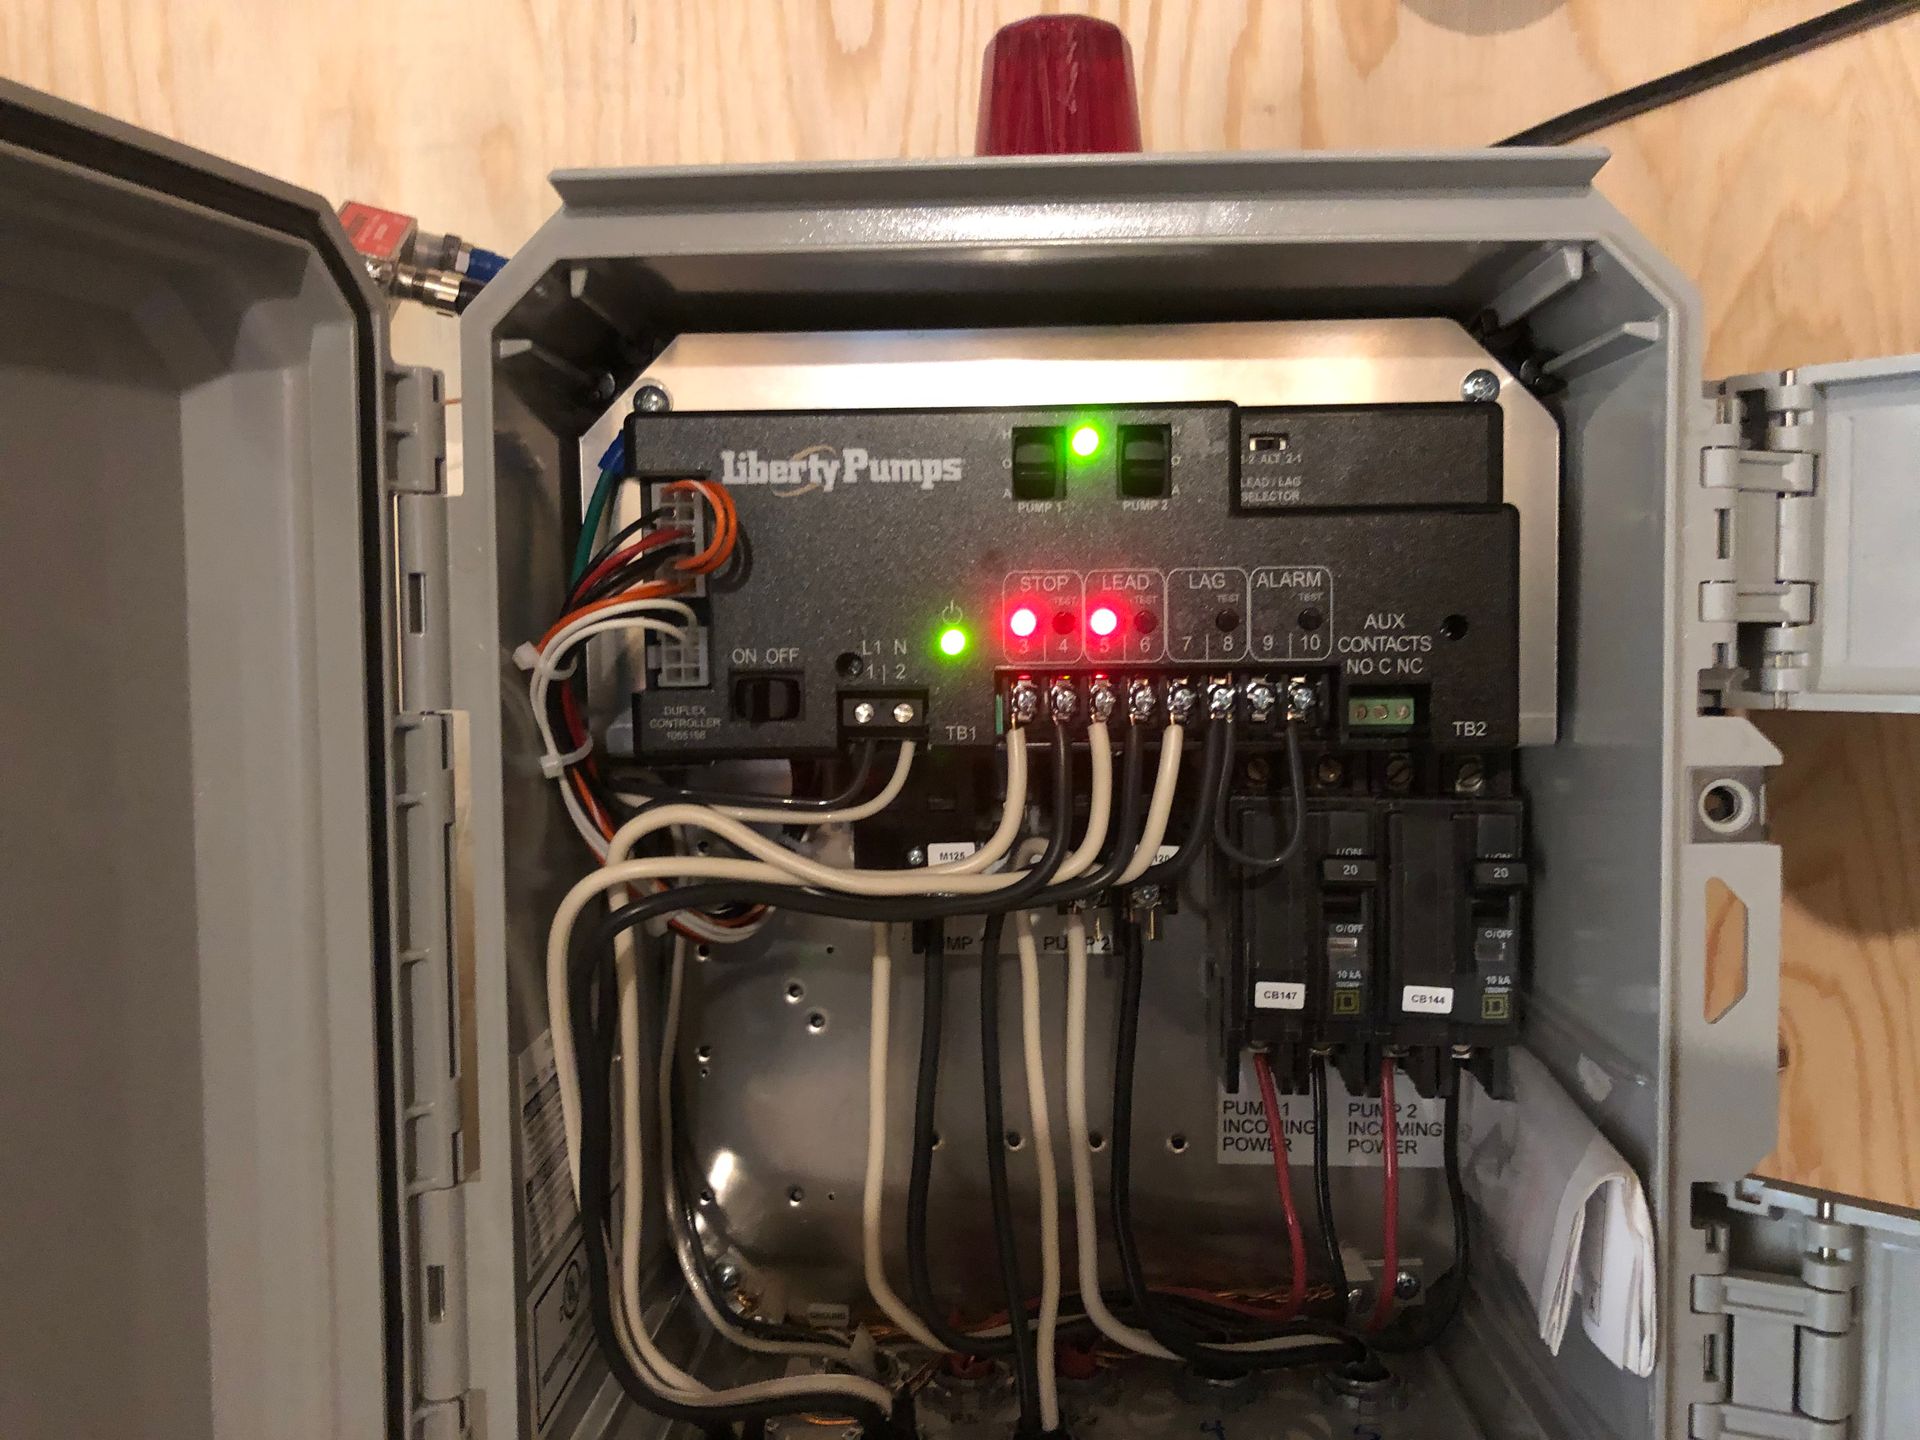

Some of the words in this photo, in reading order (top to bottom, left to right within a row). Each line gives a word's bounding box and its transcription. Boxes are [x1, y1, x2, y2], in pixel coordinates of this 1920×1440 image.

[1172, 427, 1182, 436] H
[1260, 454, 1280, 464] ALT
[720, 449, 839, 492] Liberty
[842, 448, 962, 490] Pumps
[1241, 477, 1270, 488] LEAD
[1278, 476, 1302, 487] LAG
[1171, 485, 1182, 496] A
[1241, 490, 1300, 503] SELECTOR
[1017, 502, 1053, 513] PUMP
[1122, 500, 1157, 512] PUMP
[1160, 500, 1169, 511] 2
[1019, 575, 1069, 592] STOP
[1102, 574, 1150, 590] LEAD
[1188, 572, 1226, 589] LAG
[1255, 571, 1321, 589] ALARM
[1133, 595, 1158, 605] TEST
[1215, 593, 1240, 604] TEST
[1297, 592, 1324, 602] TEST
[1363, 613, 1406, 630] AUX
[862, 640, 882, 656] L1
[894, 640, 908, 655] N
[1018, 638, 1030, 654] 3
[1057, 638, 1069, 653] 4
[1099, 637, 1111, 653] 5
[1139, 636, 1152, 653] 6
[1181, 635, 1193, 652] 7
[1222, 635, 1234, 652] 8
[1262, 634, 1274, 651] 9
[1300, 633, 1321, 651] 10
[1337, 635, 1433, 653] CONTACTS
[732, 648, 757, 664] ON
[765, 647, 800, 665] OFF
[866, 665, 874, 680] 1
[895, 665, 907, 680] 2
[1345, 658, 1373, 675] NO
[1378, 658, 1391, 674] C
[1397, 657, 1424, 674] NC
[649, 717, 721, 729] CONTROLLER
[1452, 721, 1488, 737] TB2
[946, 725, 977, 741] TB1
[939, 852, 965, 861] M125
[1342, 864, 1359, 876] 20
[1493, 867, 1509, 879] 20
[1043, 935, 1095, 951] PUP
[1101, 935, 1111, 951] 2
[1337, 970, 1348, 979] 10
[1263, 991, 1298, 1000] CB147
[1411, 994, 1445, 1005] CB144
[1223, 1101, 1266, 1116] PUM
[1282, 1102, 1289, 1116] 1
[1407, 1103, 1417, 1119] 2
[1223, 1118, 1315, 1135] INCOING
[1348, 1121, 1443, 1137] INCMING
